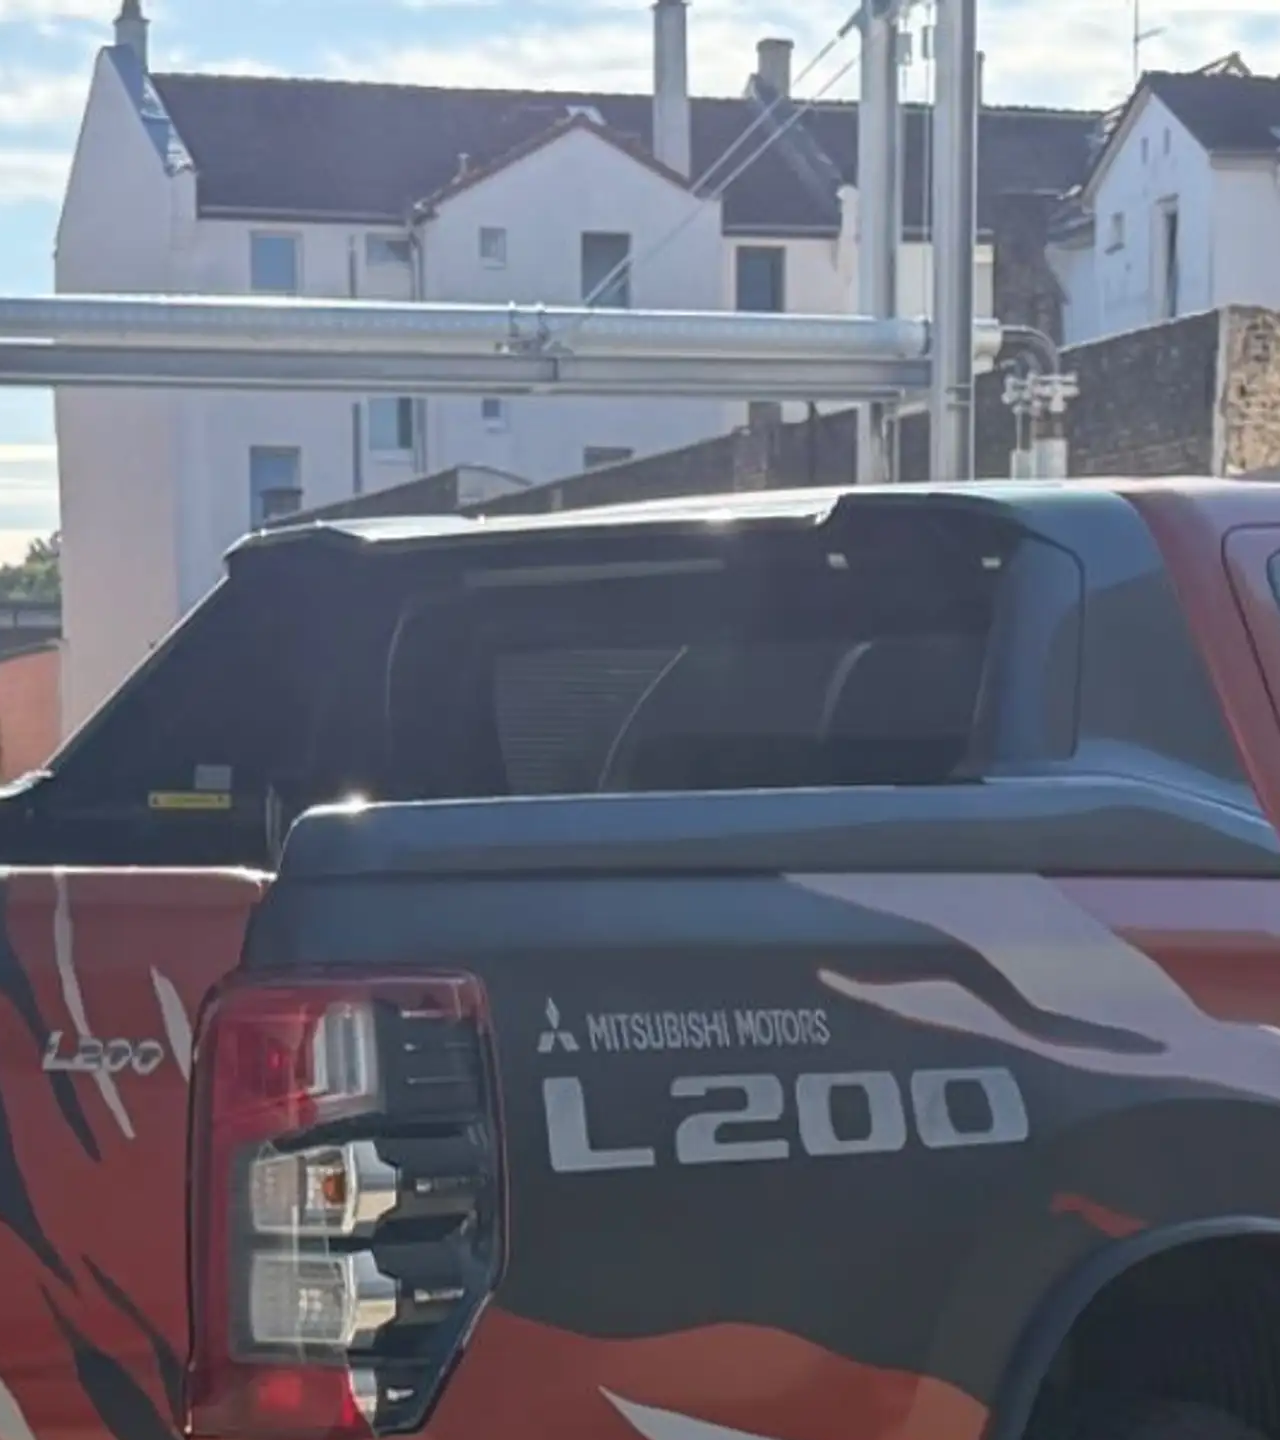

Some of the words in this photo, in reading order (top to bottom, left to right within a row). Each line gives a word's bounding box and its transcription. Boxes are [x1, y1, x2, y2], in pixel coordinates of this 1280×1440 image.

[41, 1028, 164, 1075] L200
[586, 1009, 730, 1051] MITSUBISHI
[736, 1008, 831, 1047] MOTORS
[541, 1066, 1030, 1174] L200
